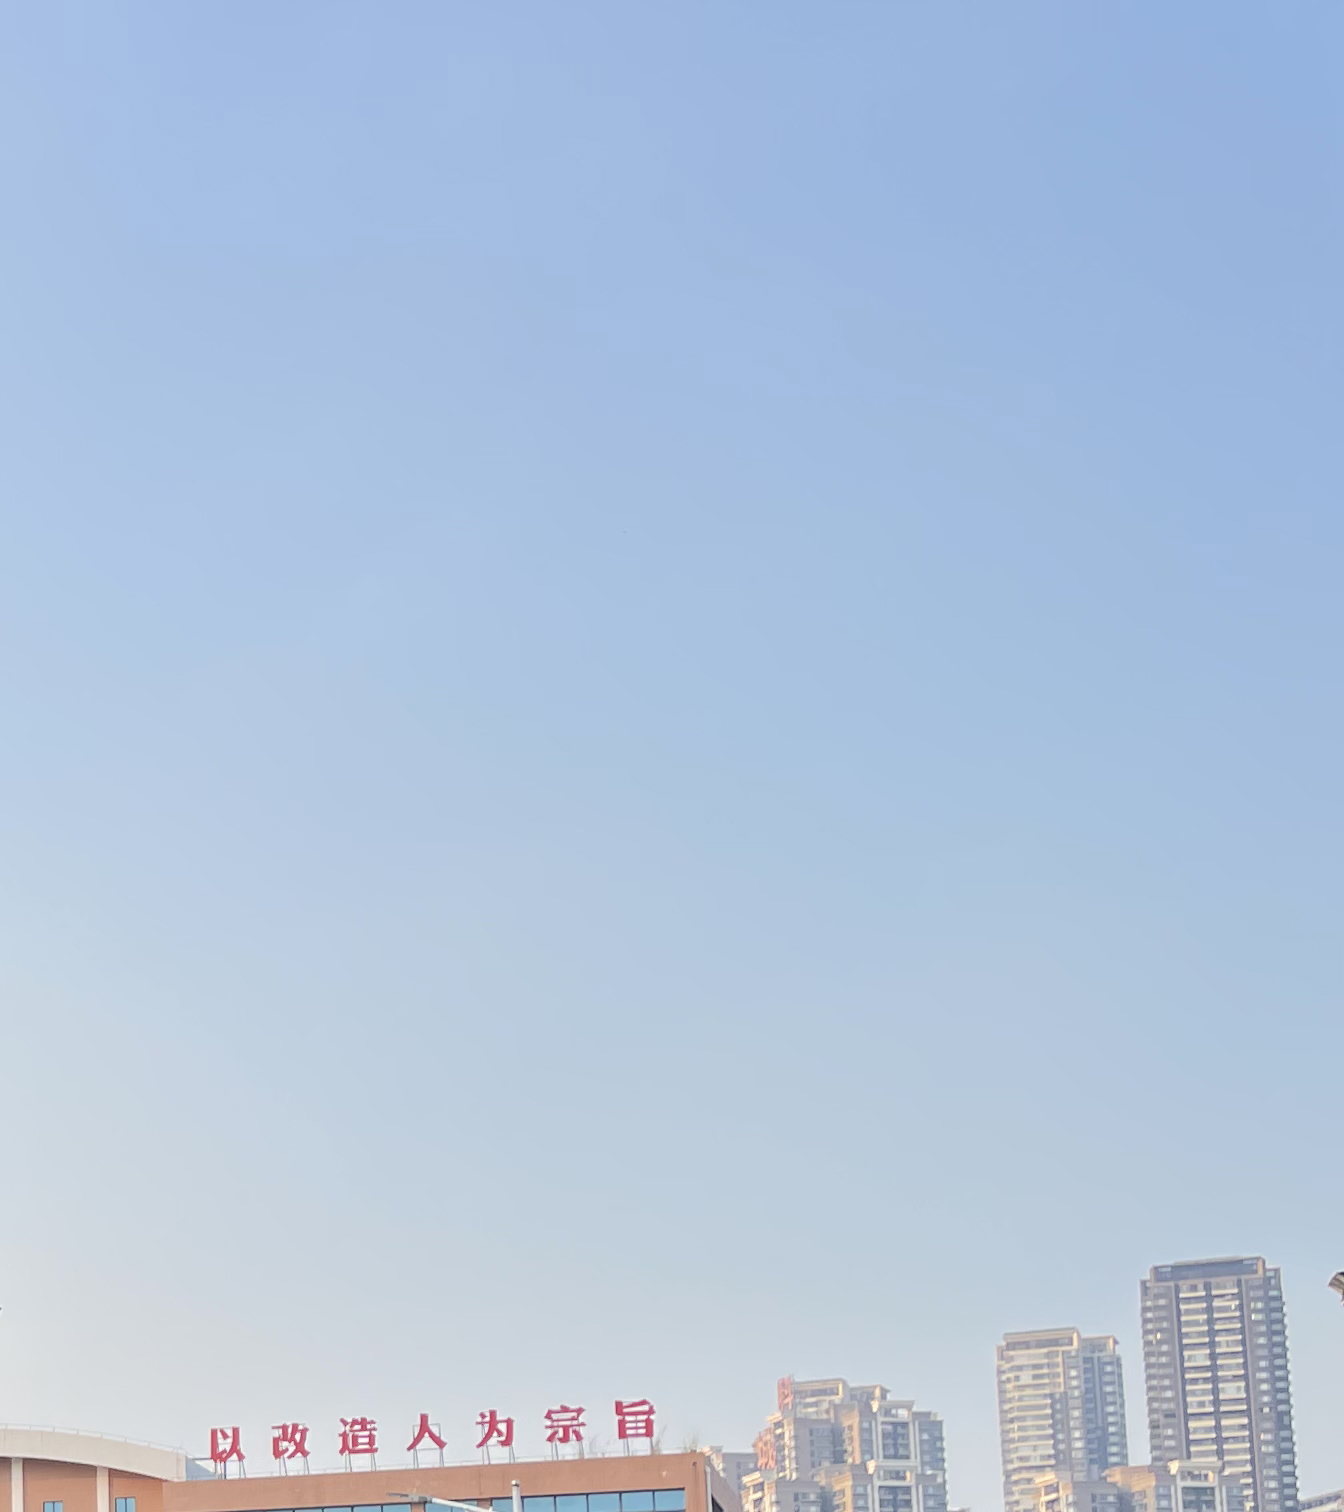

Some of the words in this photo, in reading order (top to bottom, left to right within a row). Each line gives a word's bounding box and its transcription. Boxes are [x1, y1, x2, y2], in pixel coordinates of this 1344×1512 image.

[211, 1398, 656, 1463] 以改造人为宗旨
